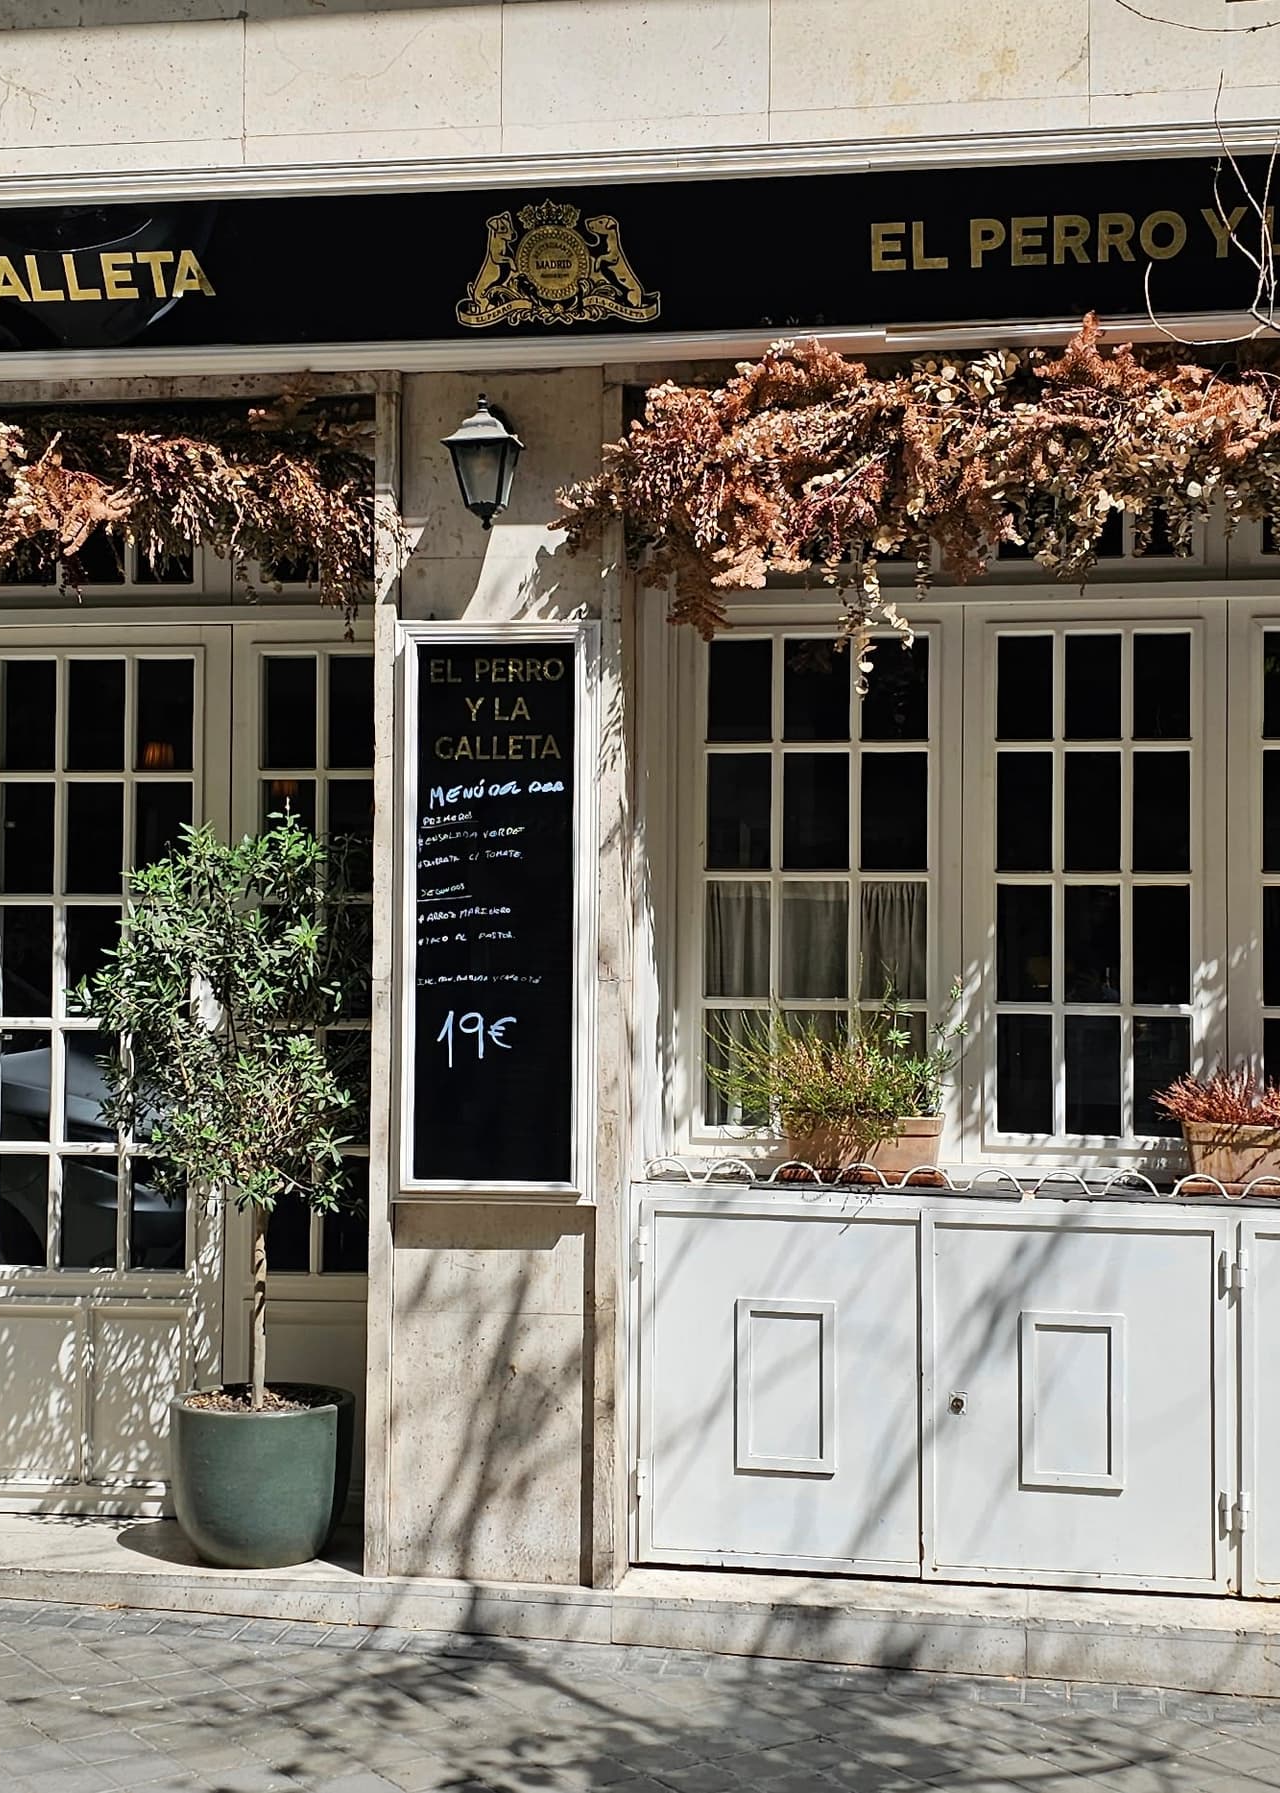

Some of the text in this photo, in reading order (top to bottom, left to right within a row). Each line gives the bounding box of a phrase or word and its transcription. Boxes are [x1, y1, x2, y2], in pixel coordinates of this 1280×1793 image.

[871, 222, 948, 272] EL
[970, 210, 1186, 267] PERRO
[1201, 206, 1248, 258] Y
[535, 259, 572, 270] MADRID
[430, 657, 565, 683] EL PERRO
[465, 697, 531, 721] Y LA
[435, 735, 562, 760] GALLETA
[436, 1010, 518, 1068] 19€
